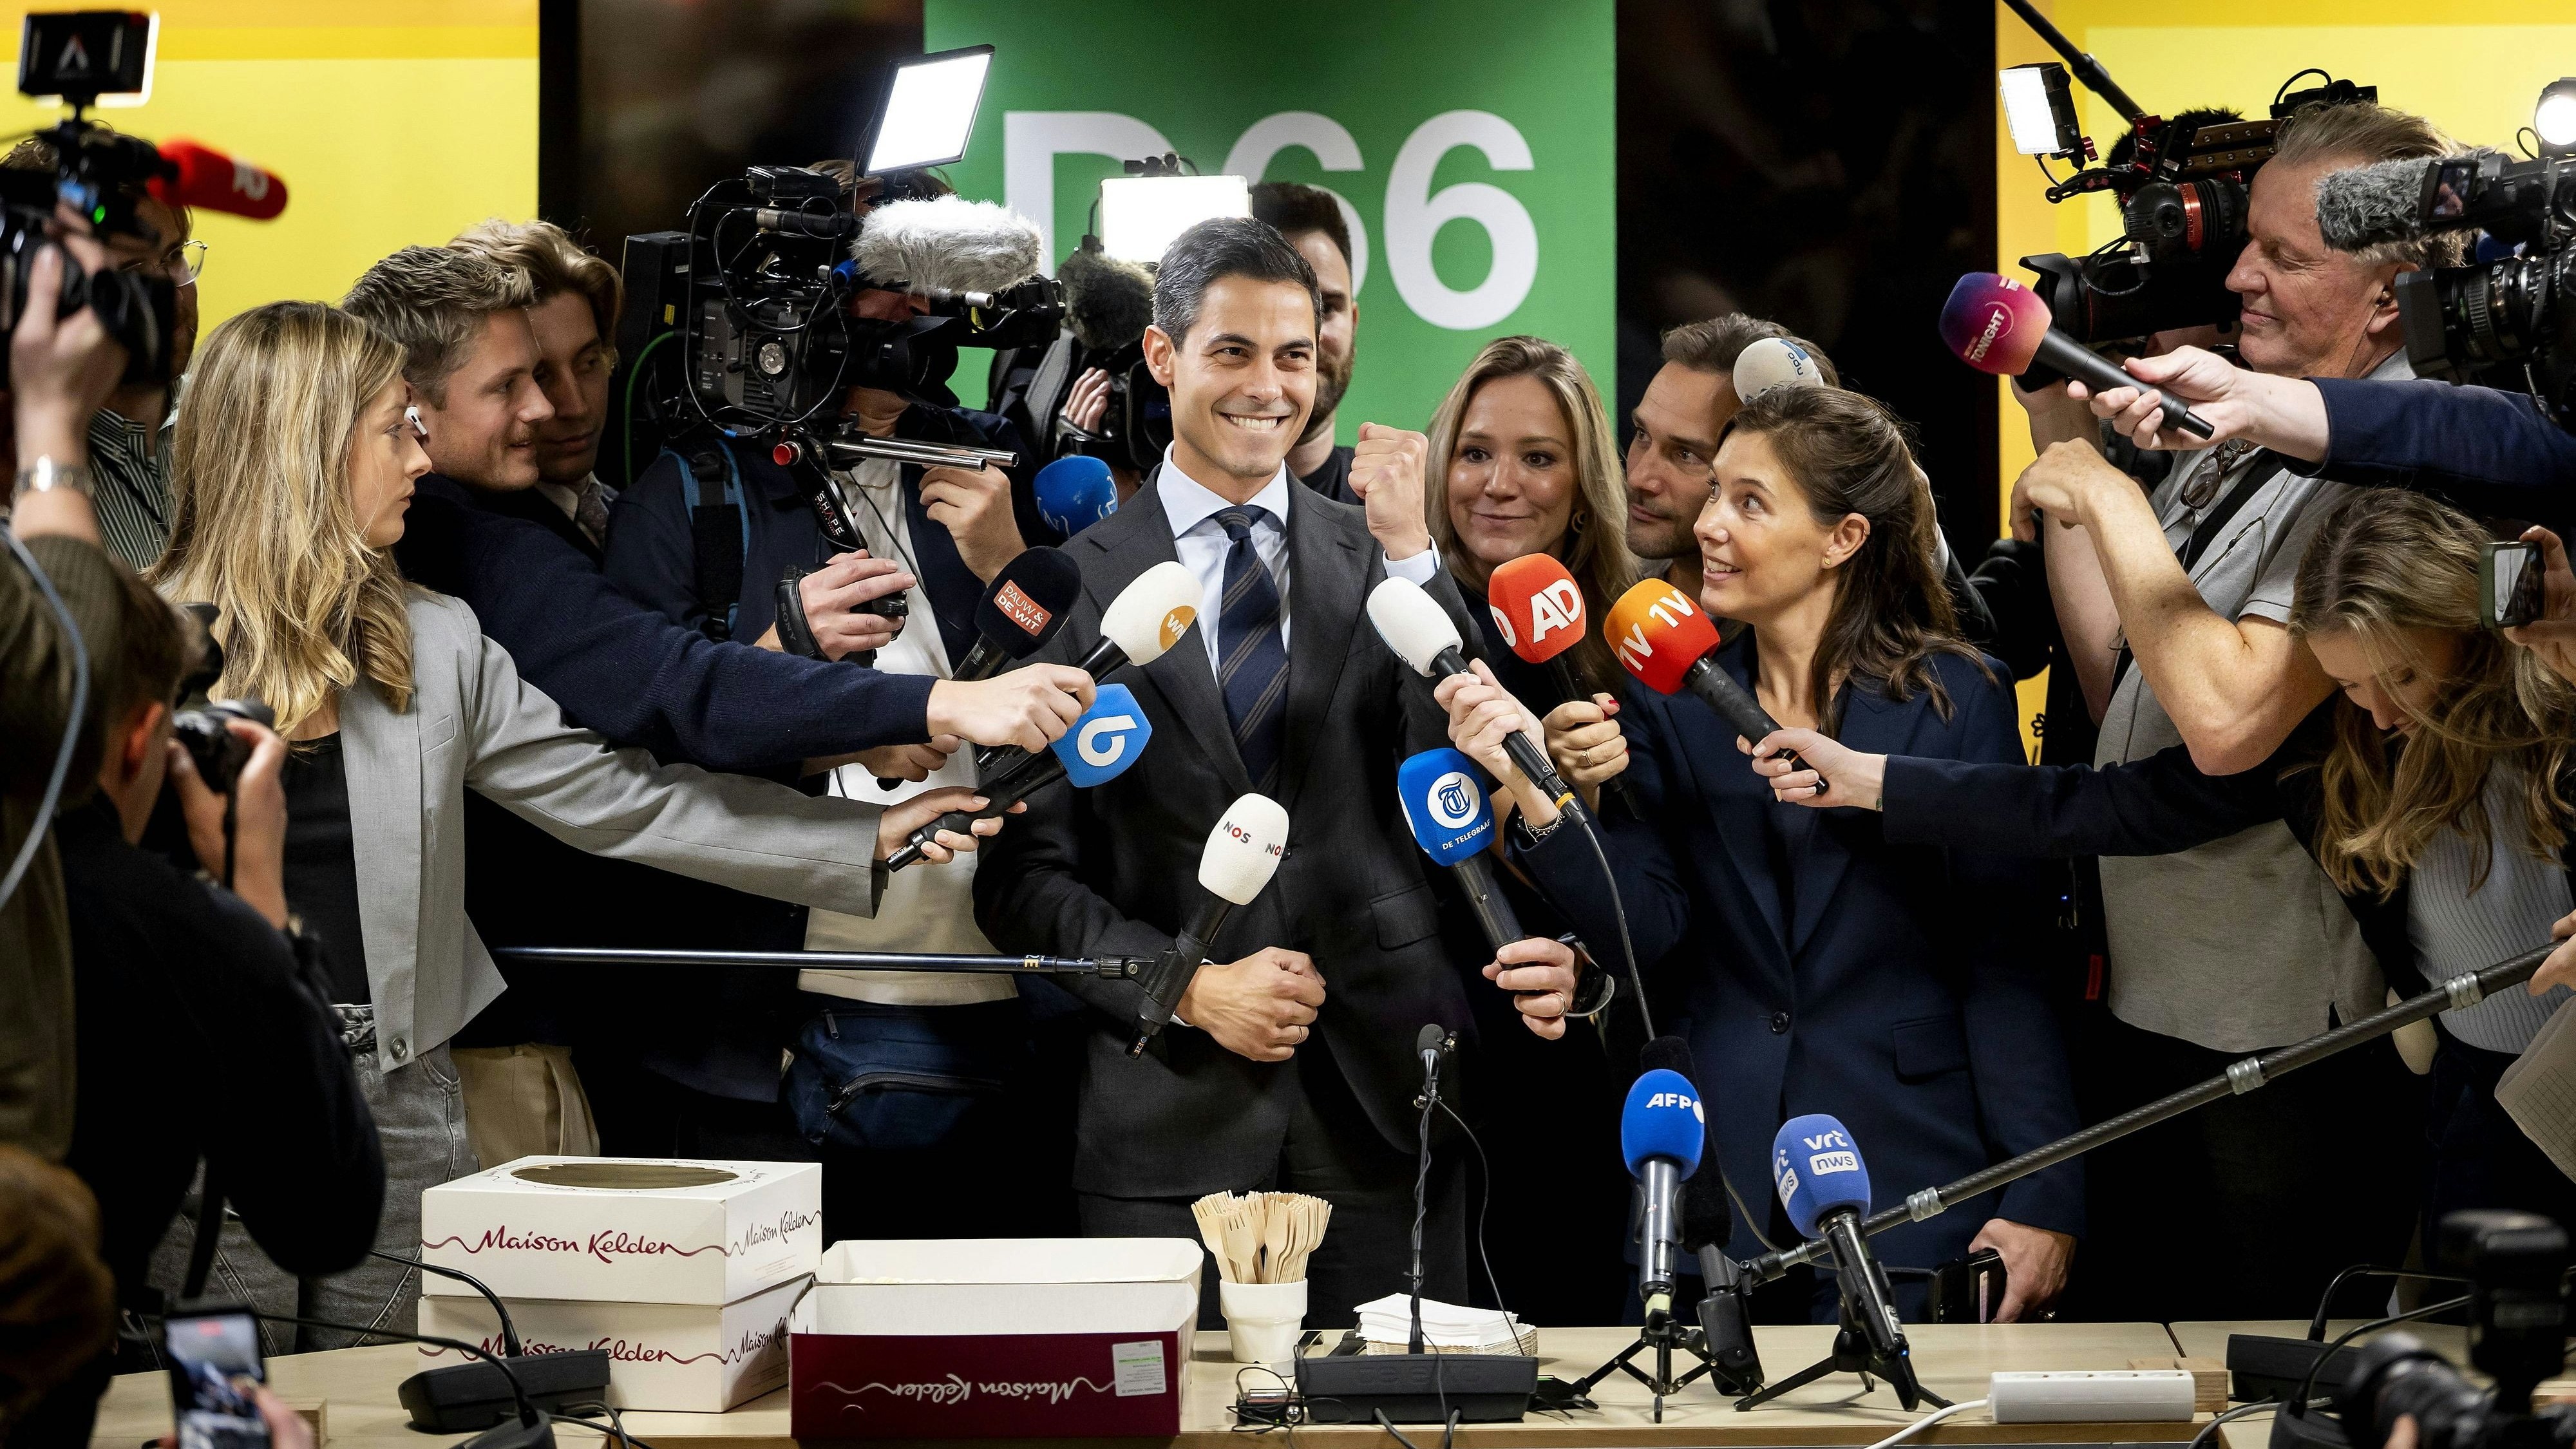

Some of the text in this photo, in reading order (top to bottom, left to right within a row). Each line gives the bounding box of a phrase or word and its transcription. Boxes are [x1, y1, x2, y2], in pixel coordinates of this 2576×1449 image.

[1969, 308, 2005, 363] TONIGHT
[817, 493, 845, 536] SHAPE
[998, 594, 1039, 629] DE WIT
[1004, 585, 1044, 623] PAUW &
[1530, 578, 1581, 643] AD
[1223, 820, 1251, 844] NOS
[1442, 819, 1492, 851] DE TELEGRAAF
[1645, 1093, 1692, 1109] AFP
[1803, 1130, 1848, 1150] vrt
[1816, 1156, 1853, 1170] nws
[482, 1225, 580, 1251] Maison
[745, 1222, 778, 1248] Maison
[741, 1329, 773, 1354] Maison
[978, 1382, 1074, 1405] Maison
